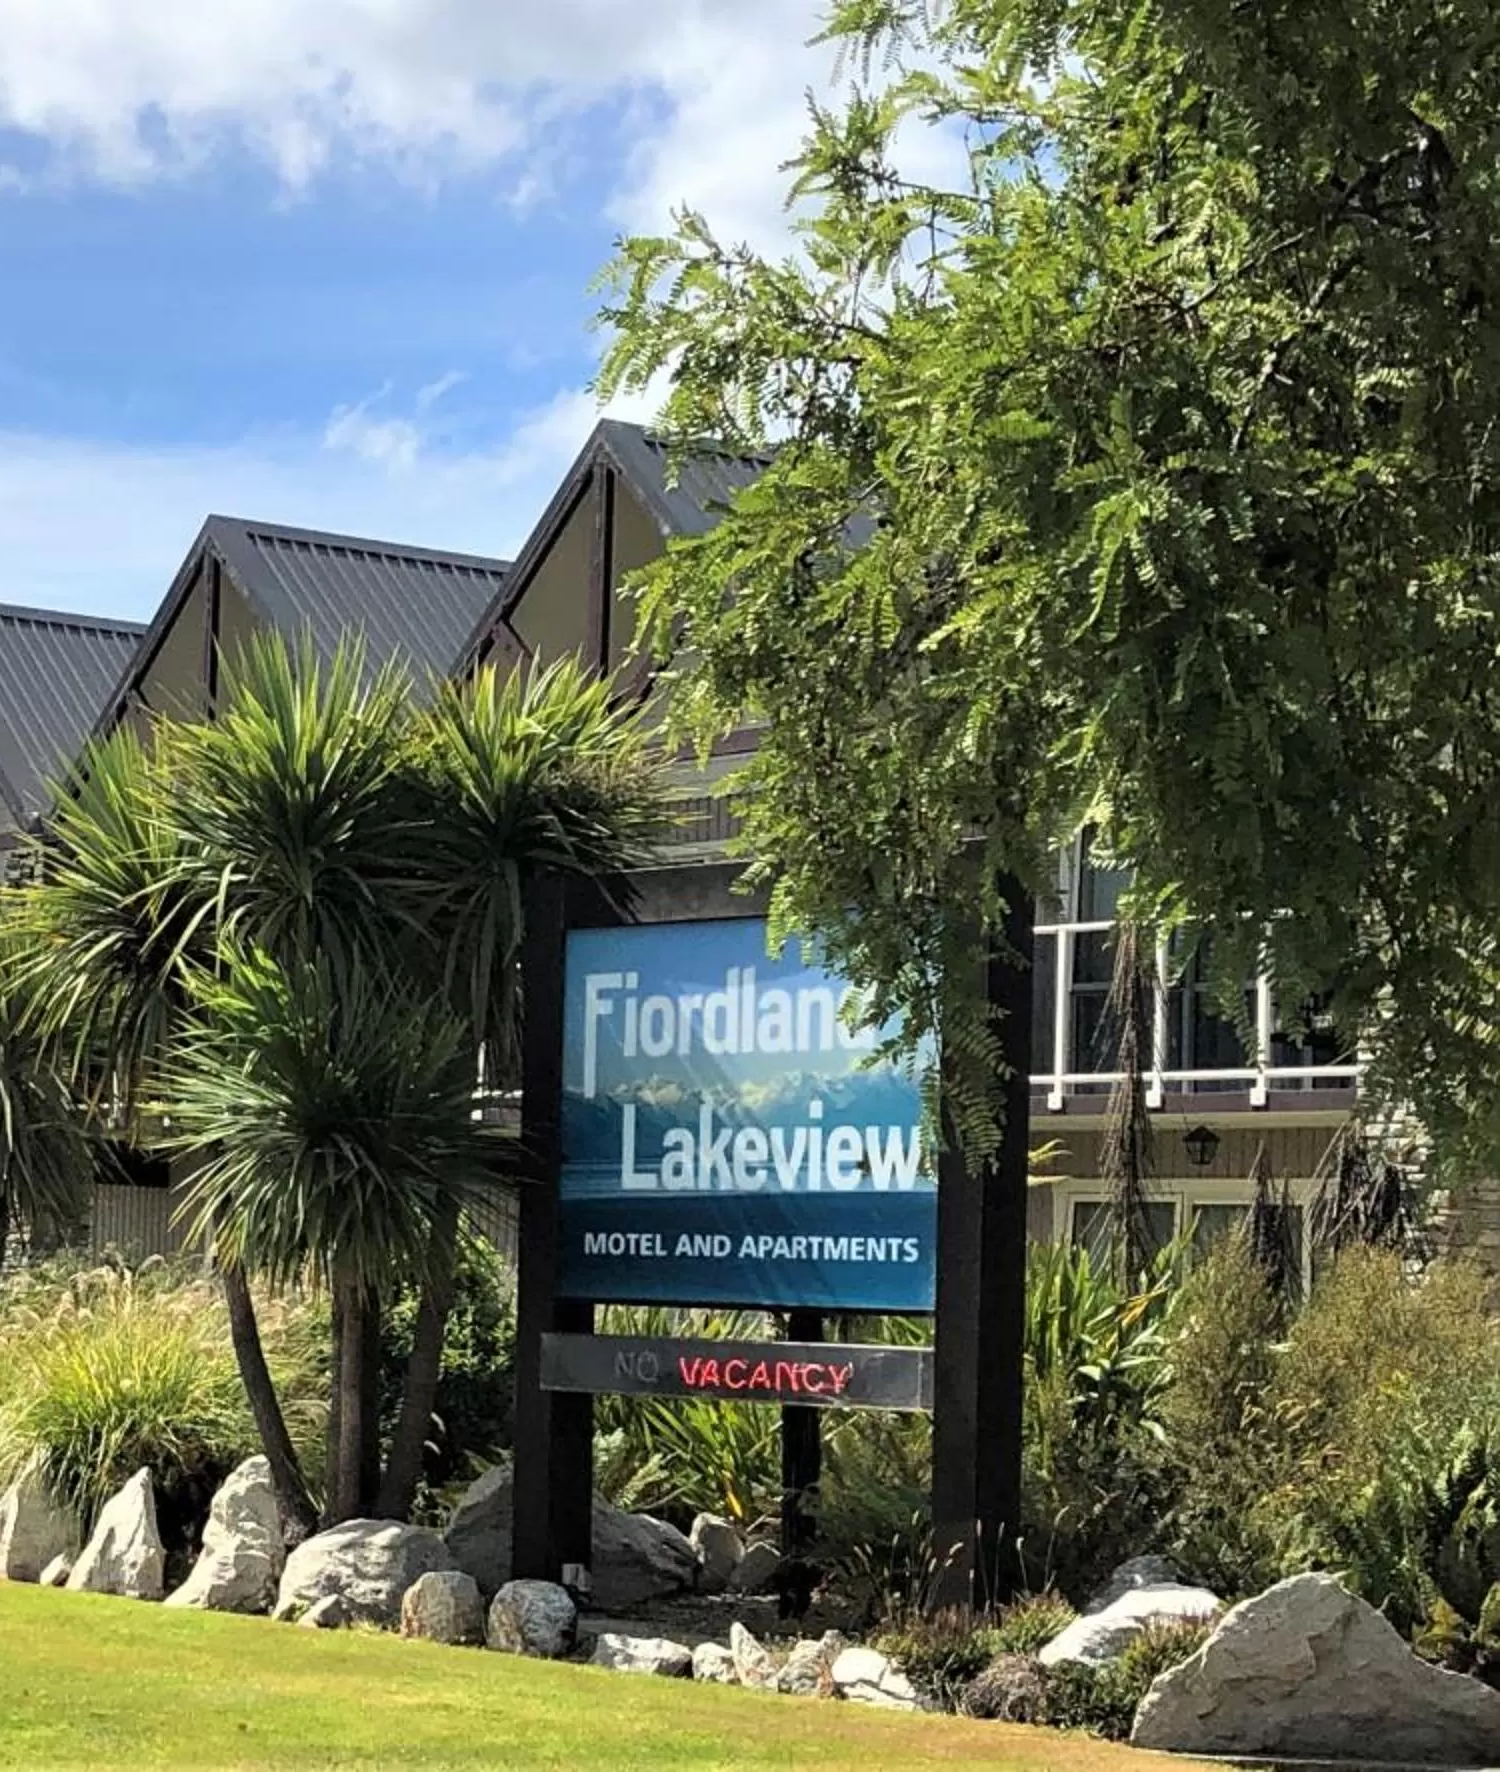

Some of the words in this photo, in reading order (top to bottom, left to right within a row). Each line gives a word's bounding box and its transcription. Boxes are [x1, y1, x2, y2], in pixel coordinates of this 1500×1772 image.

[621, 1101, 921, 1192] Lakeview
[585, 1233, 668, 1257] MOTEL
[675, 1235, 732, 1258] AND
[738, 1236, 920, 1263] APARTMENTS
[614, 1351, 659, 1382] NO
[678, 1357, 851, 1393] VACANCY
